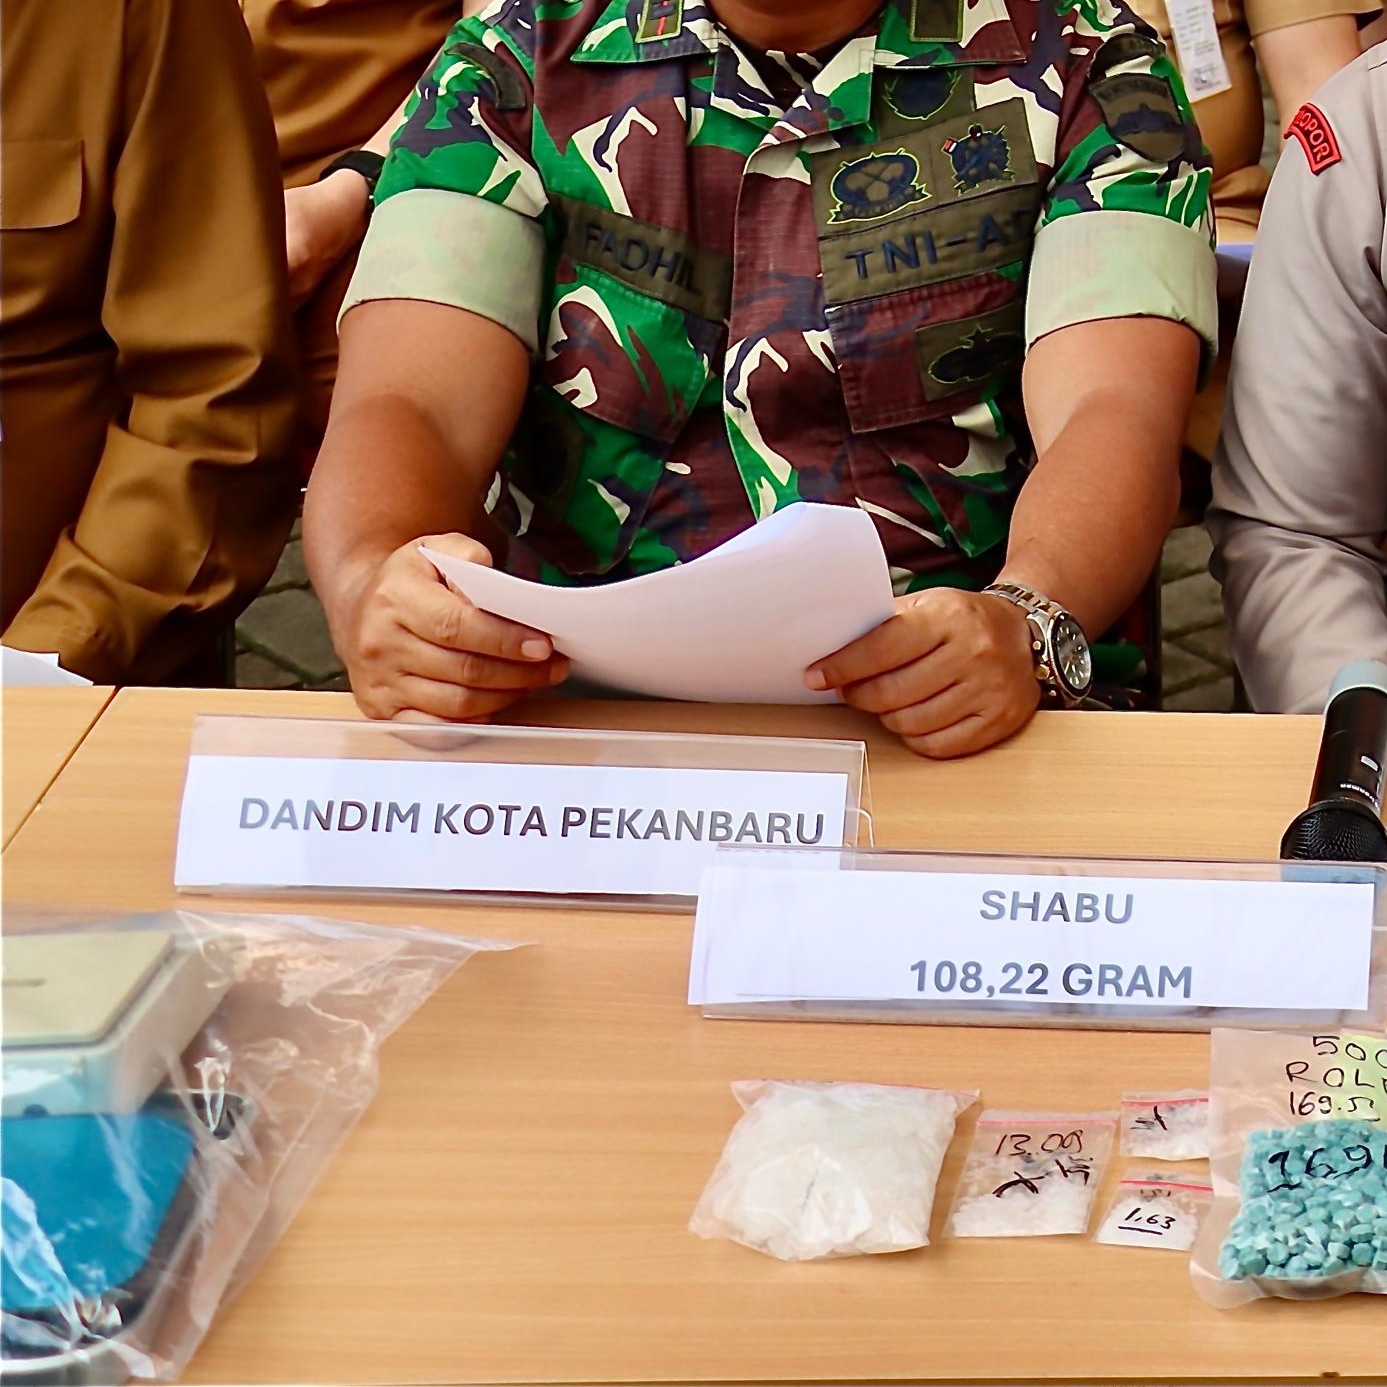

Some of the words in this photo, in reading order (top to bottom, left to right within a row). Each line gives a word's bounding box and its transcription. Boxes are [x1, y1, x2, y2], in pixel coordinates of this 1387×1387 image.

[239, 797, 421, 834] DANDIM
[433, 802, 548, 838] KOTA
[560, 806, 824, 845] PEKANBARU
[979, 890, 1134, 925] SHABU
[910, 960, 1049, 999] 108,22
[1062, 962, 1193, 999] GRAM
